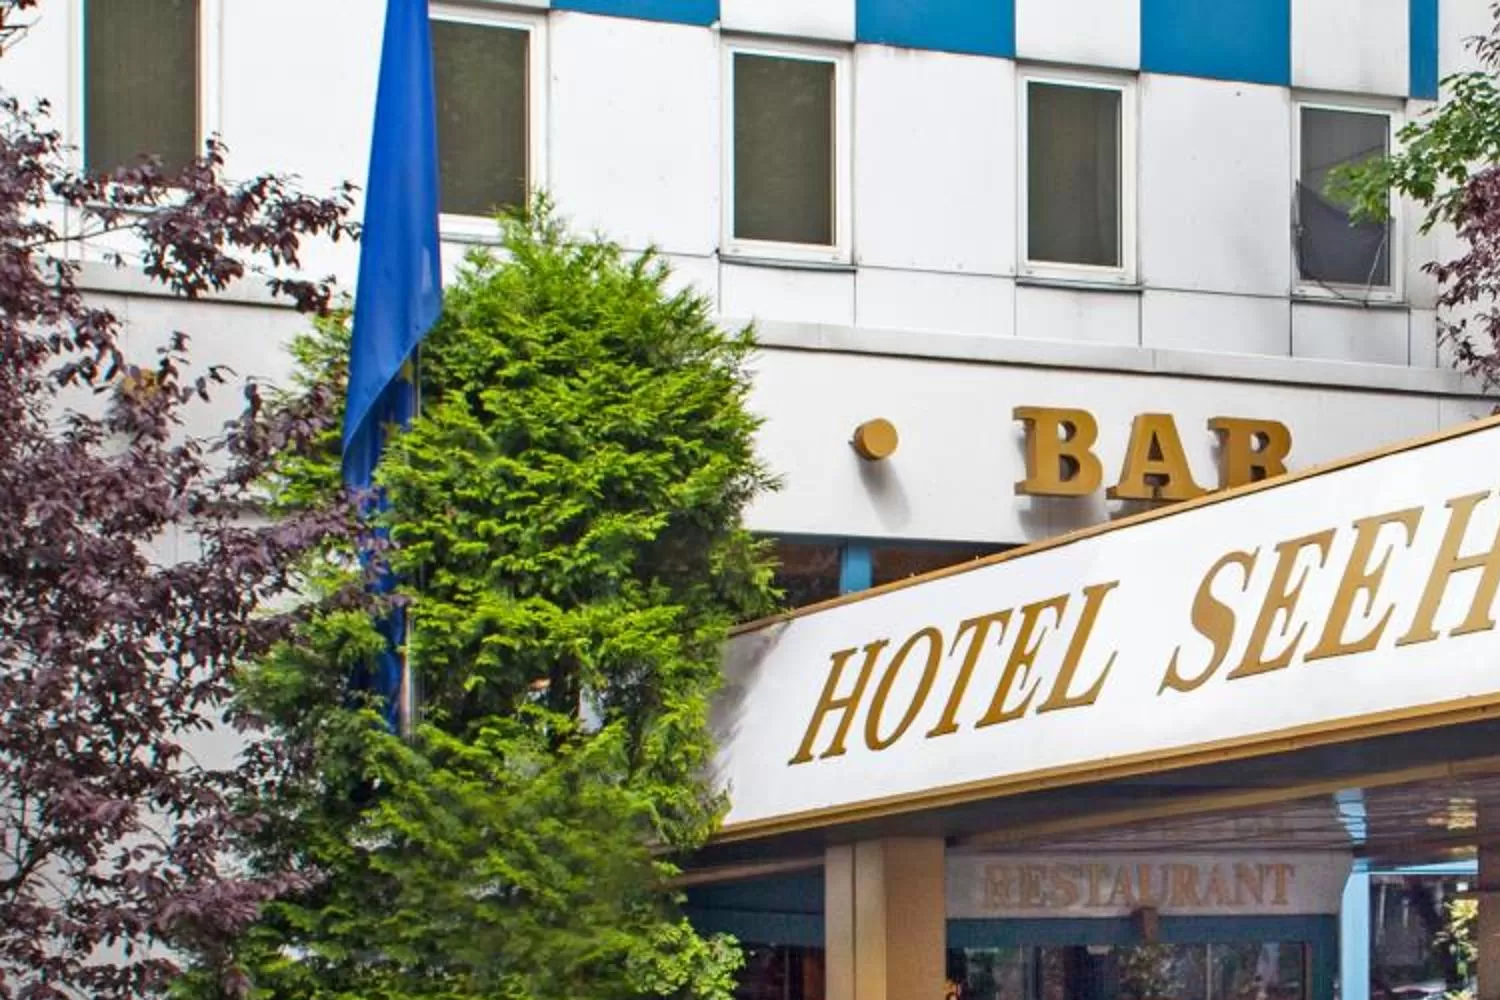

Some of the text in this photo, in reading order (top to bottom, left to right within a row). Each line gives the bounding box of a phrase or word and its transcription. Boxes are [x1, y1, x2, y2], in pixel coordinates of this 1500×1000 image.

[1013, 404, 1293, 502] BAR
[788, 579, 1121, 767] HOTEL
[982, 861, 1296, 909] RESTAURANT
